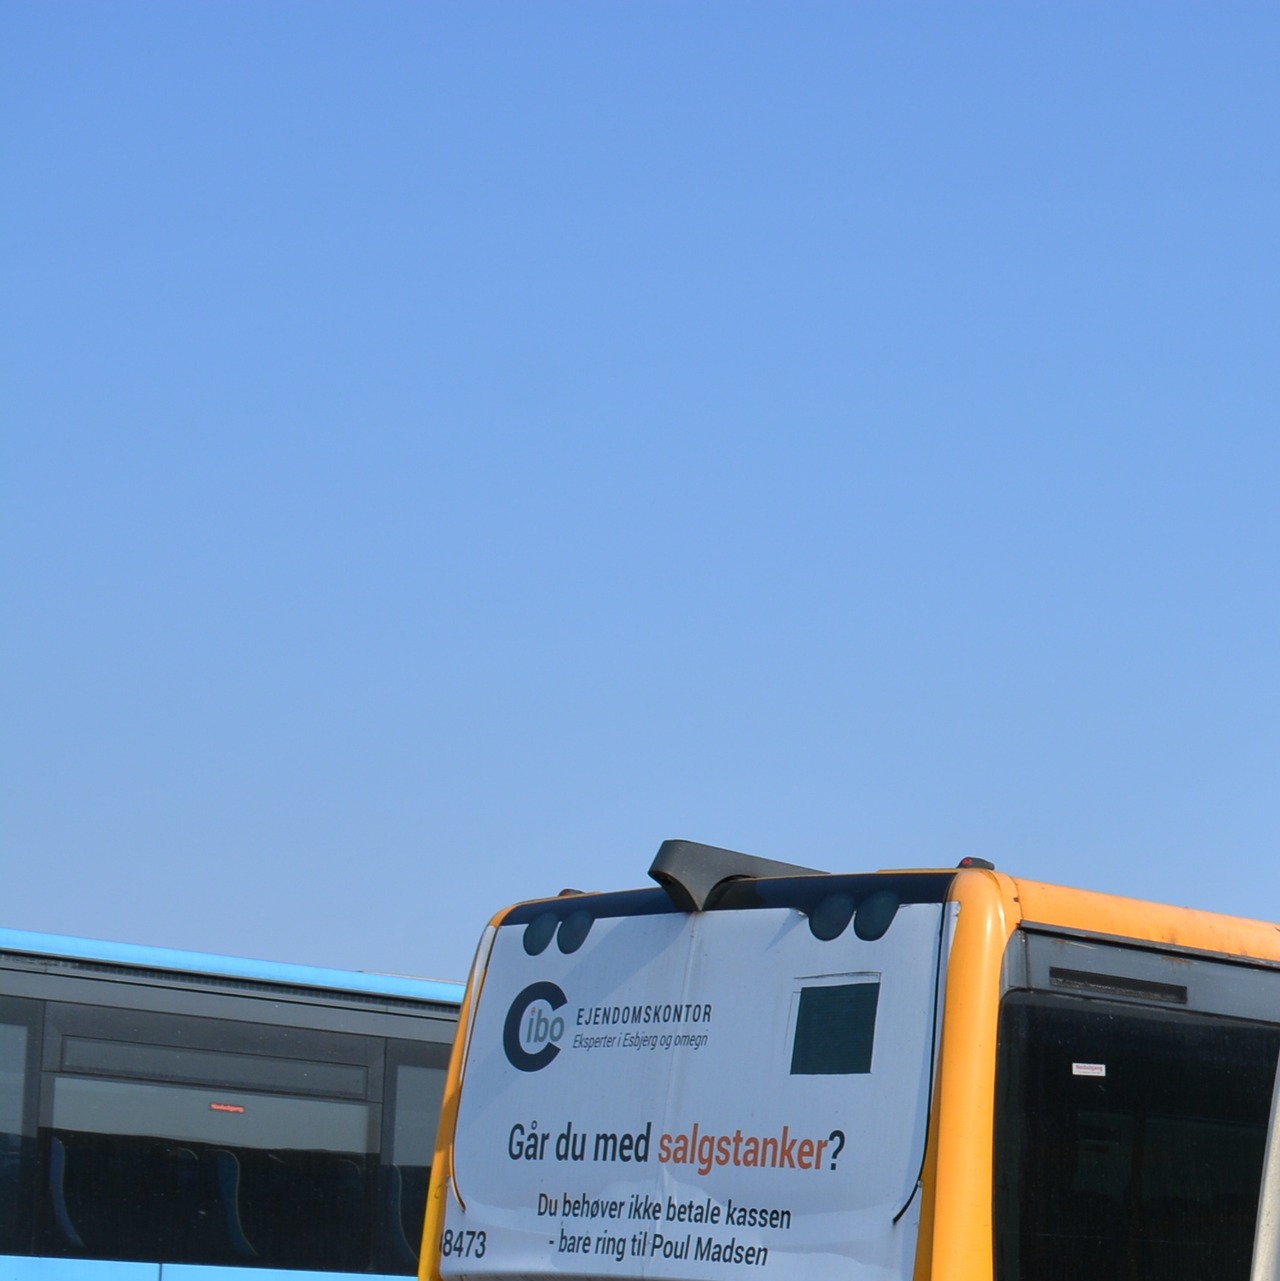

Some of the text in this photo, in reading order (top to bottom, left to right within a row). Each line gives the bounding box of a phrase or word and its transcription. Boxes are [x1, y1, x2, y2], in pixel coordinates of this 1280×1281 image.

[576, 1004, 712, 1026] EJENDOMSKONTOR
[573, 1031, 708, 1051] Eksperter i Esbjerg og omegn
[508, 1120, 846, 1176] Går du med salgstanker?
[537, 1192, 792, 1229] Du behøver ikke betale kassen
[558, 1228, 591, 1254] bare
[595, 1230, 625, 1262] ring
[630, 1231, 648, 1257] til
[651, 1233, 691, 1261] Poul
[694, 1237, 769, 1266] Madsen
